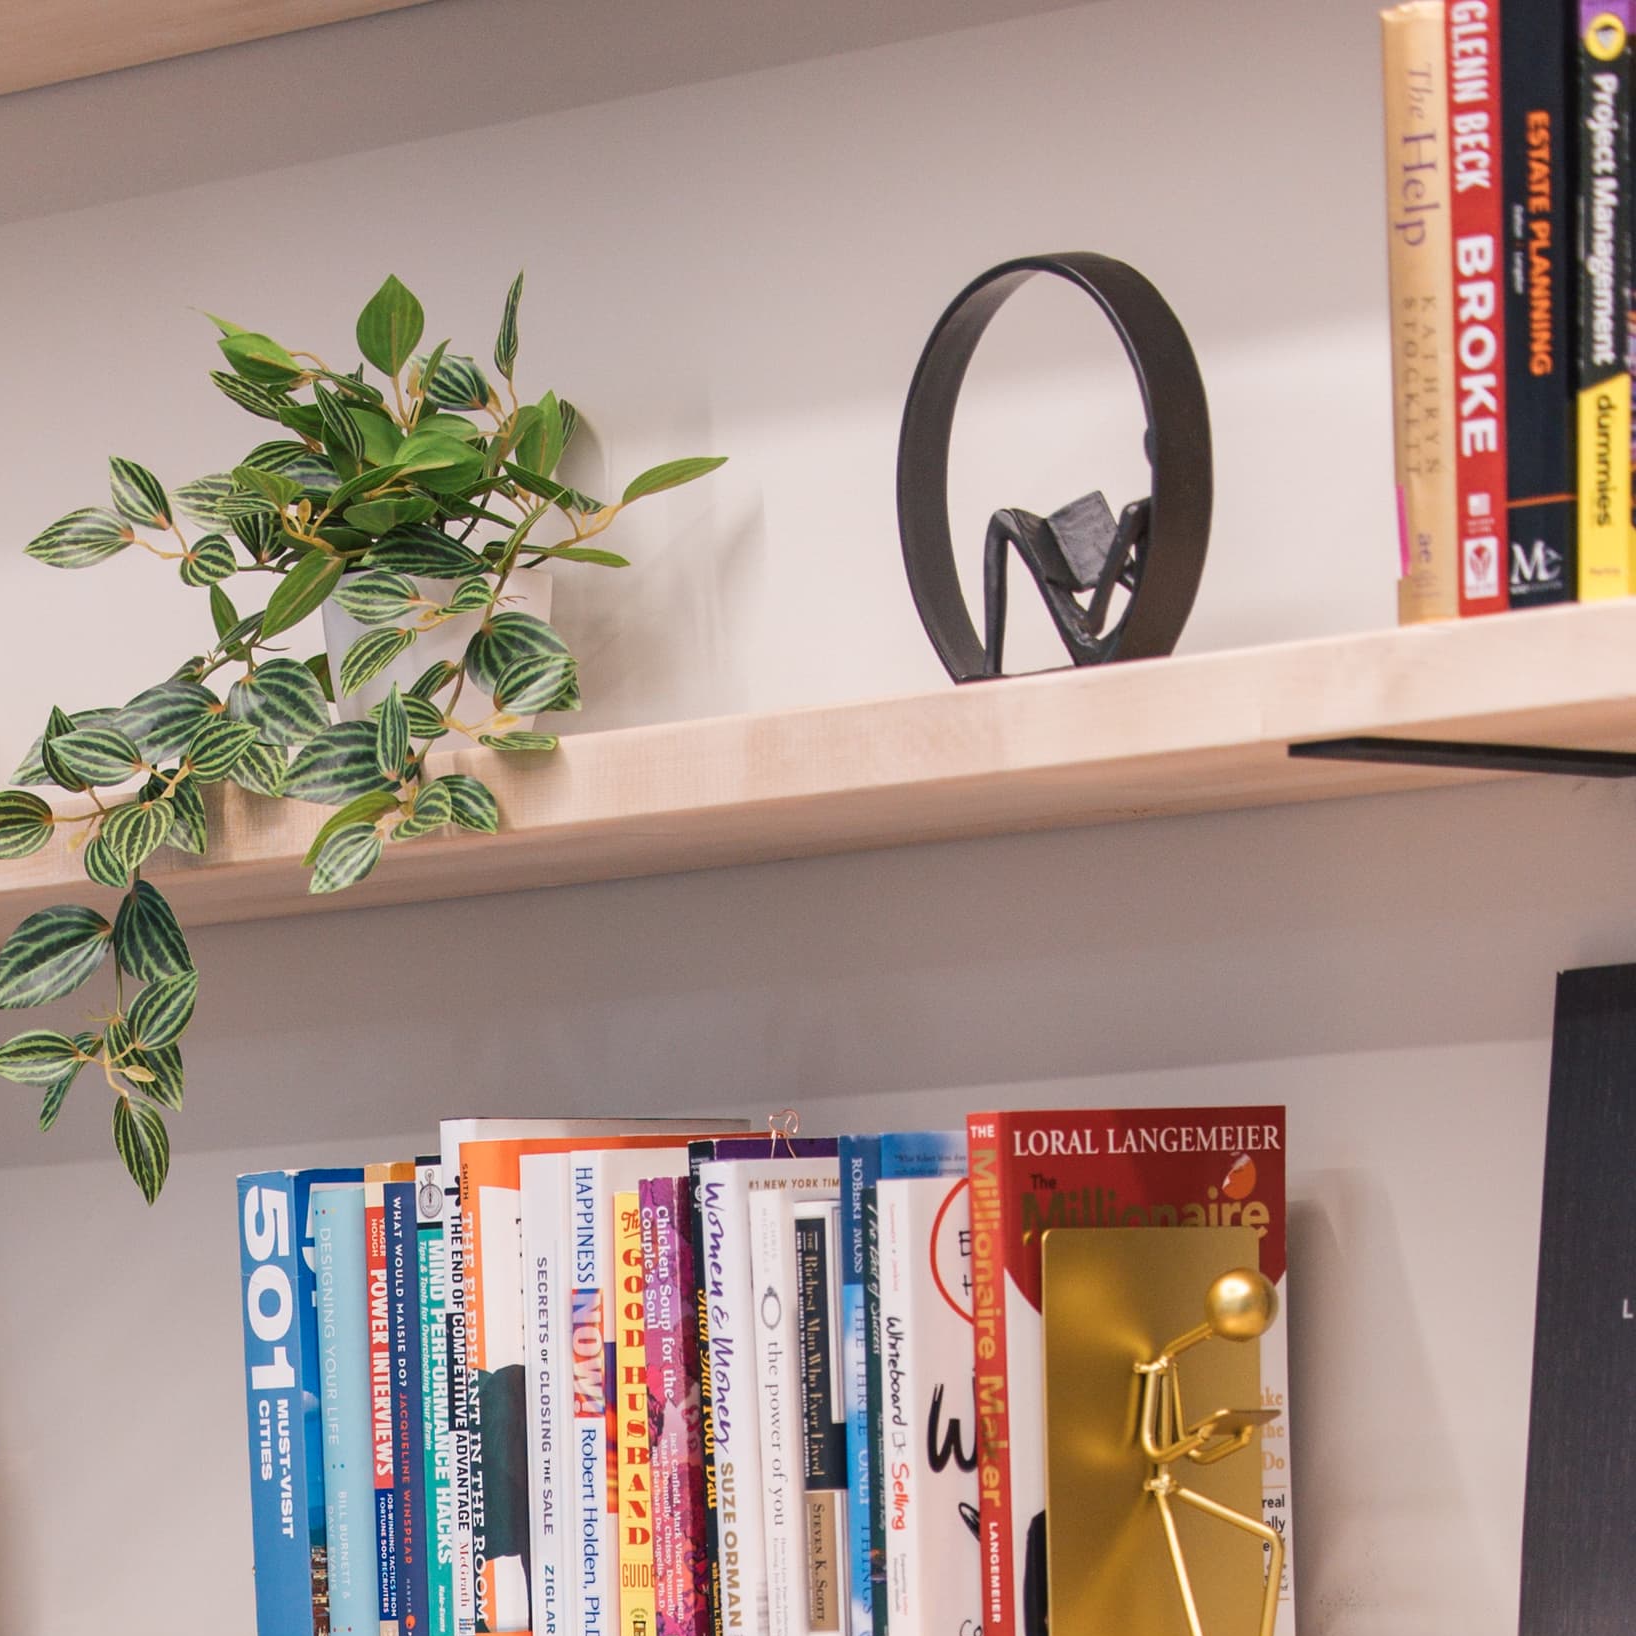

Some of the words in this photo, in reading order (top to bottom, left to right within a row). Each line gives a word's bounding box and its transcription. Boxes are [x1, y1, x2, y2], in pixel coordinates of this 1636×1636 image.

[1450, 1, 1489, 104] GLENN
[1407, 62, 1433, 120] The
[1453, 111, 1491, 192] BECK
[1585, 73, 1619, 175] Project
[1395, 130, 1441, 247] Help
[1526, 110, 1552, 214] ESTATE
[1528, 219, 1554, 377] PLANNING
[1586, 177, 1618, 367] Management
[1457, 234, 1498, 458] BROKE
[1402, 295, 1421, 476] STOCKETT
[1421, 294, 1440, 475] KATHRYN
[1596, 394, 1617, 527] dummies
[970, 1124, 995, 1138] THE
[1014, 1128, 1099, 1156] LORAL
[1107, 1125, 1282, 1155] LANGEMEIER
[748, 1178, 760, 1190] #1
[764, 1179, 787, 1190] NEW
[791, 1178, 818, 1189] YORK
[851, 1157, 863, 1221] ROBERT
[1021, 1185, 1271, 1232] Millionaire
[1030, 1173, 1057, 1190] The
[370, 1218, 379, 1257] HOUGH
[379, 1217, 387, 1257] YEAGER
[392, 1197, 402, 1239] WHAT
[450, 1213, 462, 1245] THE
[465, 1211, 474, 1268] THE
[575, 1167, 595, 1283] HAPPINESS
[641, 1206, 656, 1284] Couple's
[655, 1205, 670, 1278] Chicken
[704, 1182, 725, 1296] Women
[394, 1244, 404, 1297] WOULD
[428, 1240, 445, 1301] MIND
[451, 1251, 463, 1283] END
[853, 1228, 864, 1274] MOSS
[971, 1148, 1001, 1361] Millionaire
[243, 1184, 296, 1390] 501
[319, 1227, 337, 1338] DESIGNING
[370, 1268, 389, 1345] POWER
[420, 1274, 428, 1300] Tools
[452, 1288, 464, 1310] OF
[535, 1257, 549, 1344] SECRETS
[622, 1248, 644, 1348] GOOD
[645, 1289, 659, 1330] Soul
[658, 1284, 672, 1331] Soup
[804, 1256, 820, 1311] Richest
[395, 1303, 406, 1353] MAISIE
[466, 1276, 481, 1425] ELEPHANT
[540, 1348, 549, 1365] OF
[571, 1290, 605, 1417] NOW!
[661, 1337, 675, 1363] for
[806, 1317, 822, 1351] Man
[855, 1304, 865, 1349] THE
[324, 1346, 339, 1400] YOUR
[397, 1359, 408, 1387] DO?
[422, 1324, 431, 1393] Overclocking
[452, 1317, 468, 1428] COMPETITIVE
[663, 1368, 675, 1401] the
[767, 1341, 783, 1377] the
[808, 1353, 822, 1388] Who
[886, 1316, 908, 1426] Whiteboard
[372, 1351, 394, 1477] INTERVIEWS
[430, 1307, 451, 1481] PERFORMANCE
[539, 1369, 552, 1453] CLOSING
[712, 1337, 735, 1454] Money
[764, 1384, 781, 1450] power
[810, 1393, 824, 1428] Ever
[856, 1358, 868, 1437] THREE
[257, 1399, 273, 1482] CITIES
[326, 1407, 340, 1446] LIFE
[399, 1393, 411, 1484] JACQUELINE
[470, 1432, 482, 1464] IN
[623, 1365, 651, 1546] HUSBAND
[661, 1438, 669, 1468] Mark
[670, 1432, 678, 1456] Jack
[810, 1433, 826, 1476] Lived
[978, 1374, 1009, 1509] Maker
[275, 1398, 294, 1539] MUST-VISIT
[455, 1434, 470, 1531] ADVANTAGE
[543, 1458, 552, 1484] THE
[581, 1428, 597, 1501] Robert
[720, 1462, 738, 1524] SUZE
[771, 1458, 788, 1482] of
[379, 1497, 387, 1537] FORTUNE
[386, 1493, 396, 1553] JOB-WINNING
[402, 1490, 413, 1565] WINSPEAR
[436, 1487, 453, 1565] HACKS
[471, 1470, 485, 1528] THE
[542, 1488, 554, 1536] SALE
[673, 1510, 682, 1539] Mark
[768, 1487, 785, 1526] you
[891, 1462, 910, 1531] Selling
[339, 1523, 351, 1585] BURNETT
[583, 1506, 600, 1590] Holden,
[674, 1542, 683, 1575] Victor
[812, 1503, 825, 1554] STEVEN
[382, 1561, 390, 1614] RECRUITERS
[388, 1555, 396, 1590] TACTICS
[474, 1535, 489, 1622] ROOM
[724, 1530, 743, 1628] ORMAN
[815, 1558, 826, 1577] K.
[860, 1523, 873, 1615] THINGS
[988, 1521, 1002, 1624] LANGEMEIER
[544, 1564, 556, 1636] ZIGLAR
[815, 1579, 828, 1623] SCOTT
